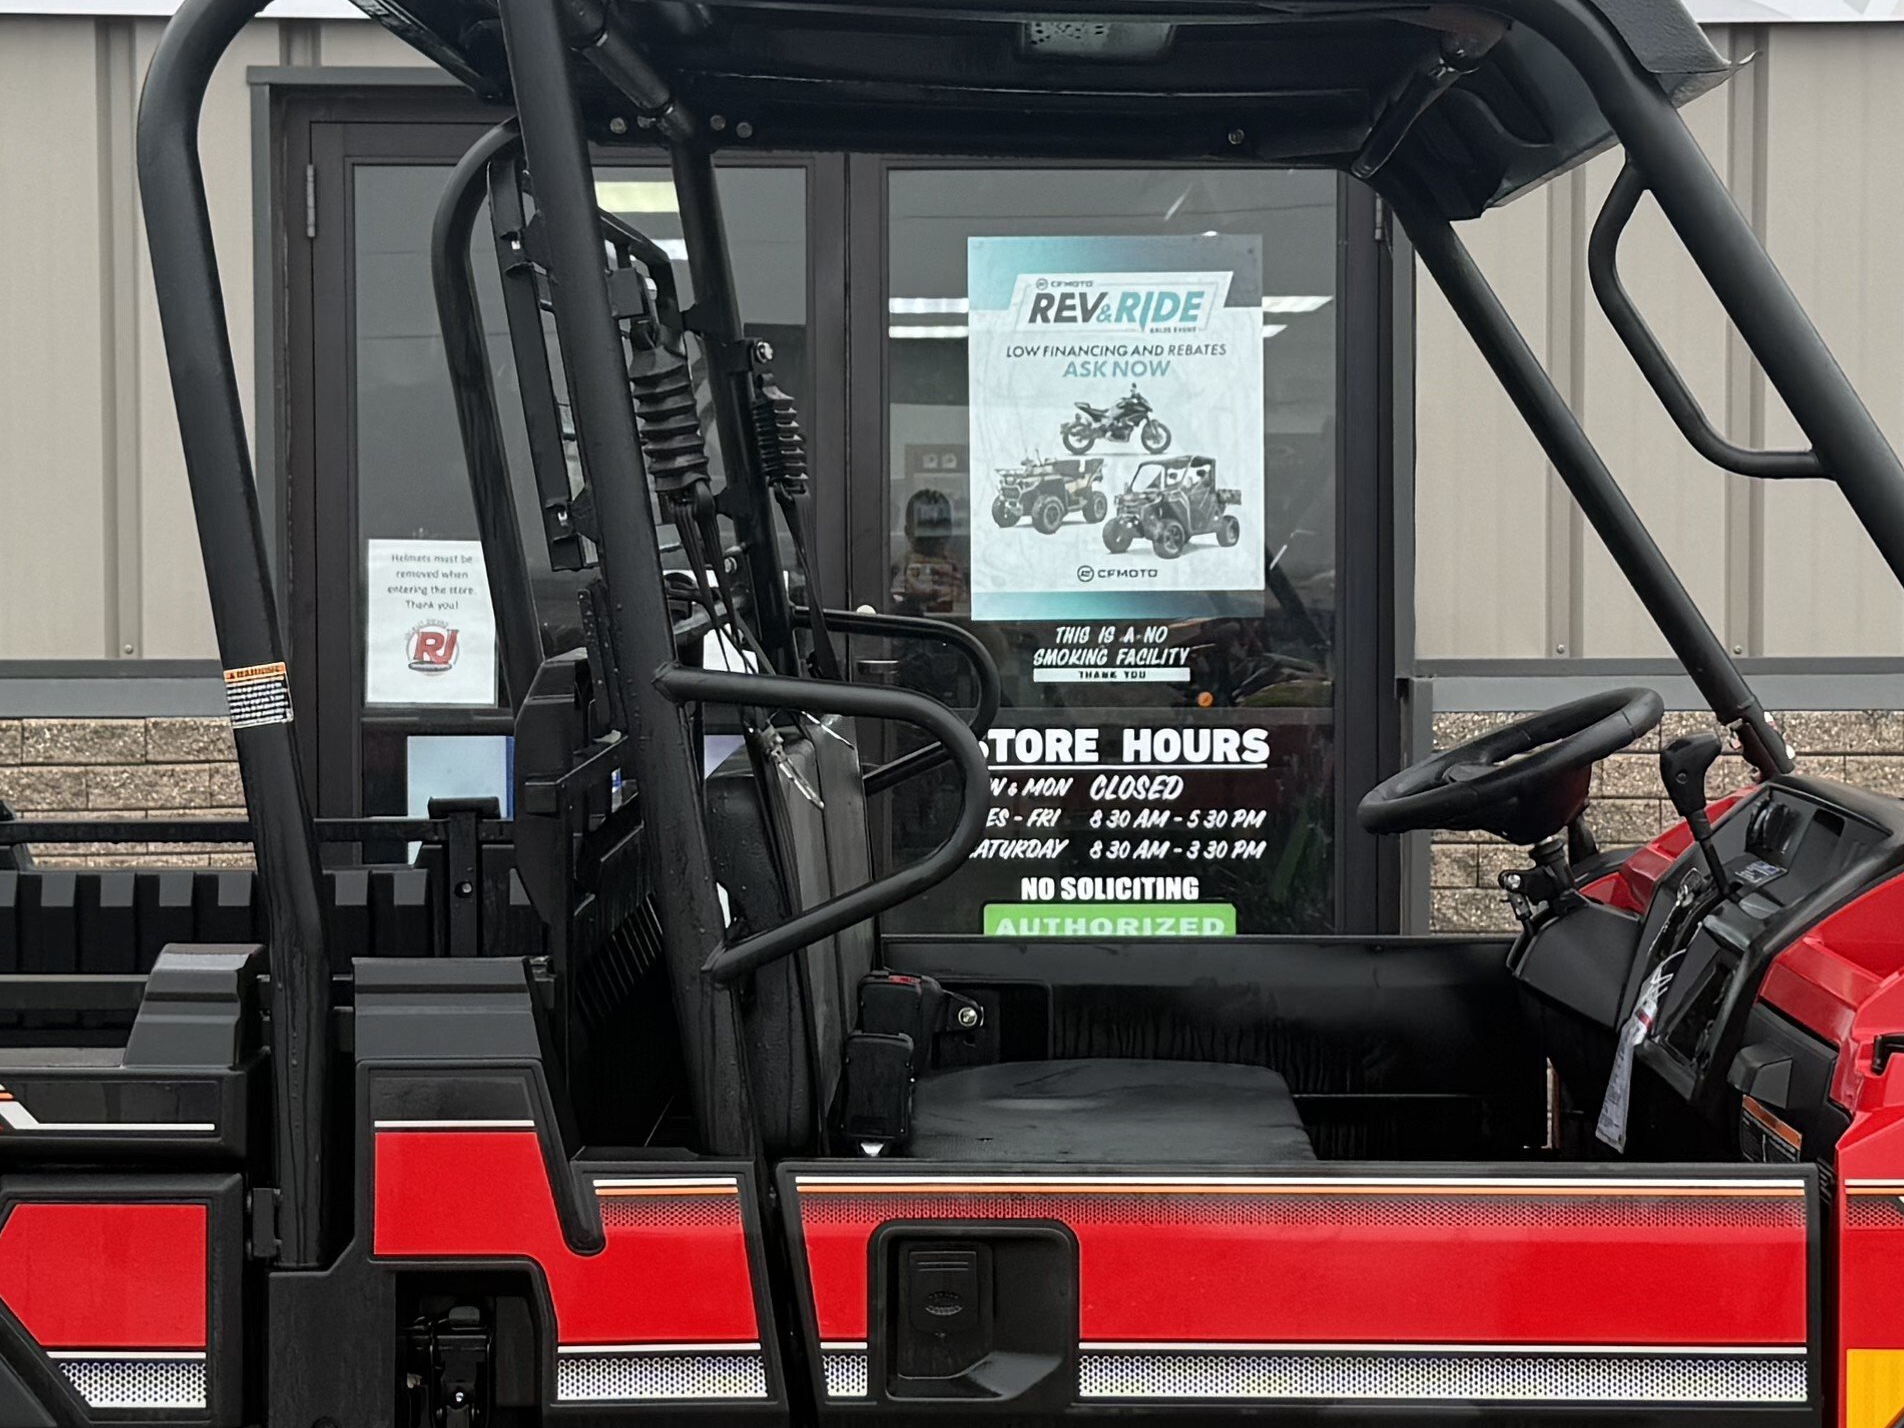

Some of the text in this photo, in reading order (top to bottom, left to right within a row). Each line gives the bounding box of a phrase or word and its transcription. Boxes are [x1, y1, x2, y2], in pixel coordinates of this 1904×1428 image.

[1006, 343, 1227, 358] LOW FINANCING AND REBATES
[1062, 360, 1171, 378] ASK NOW
[1056, 625, 1169, 644] THIS IS A NO
[1033, 647, 1190, 666] SMOKING FACILITY
[1122, 728, 1271, 764] HOURS
[1021, 777, 1074, 797] MON
[1089, 774, 1184, 800] CLOSED
[986, 807, 1010, 827] ES
[1026, 808, 1062, 827] FRI
[969, 838, 1070, 859] ATURDAY
[1021, 876, 1200, 900] NO SOLICITING
[996, 917, 1226, 936] AUTHORIZED
